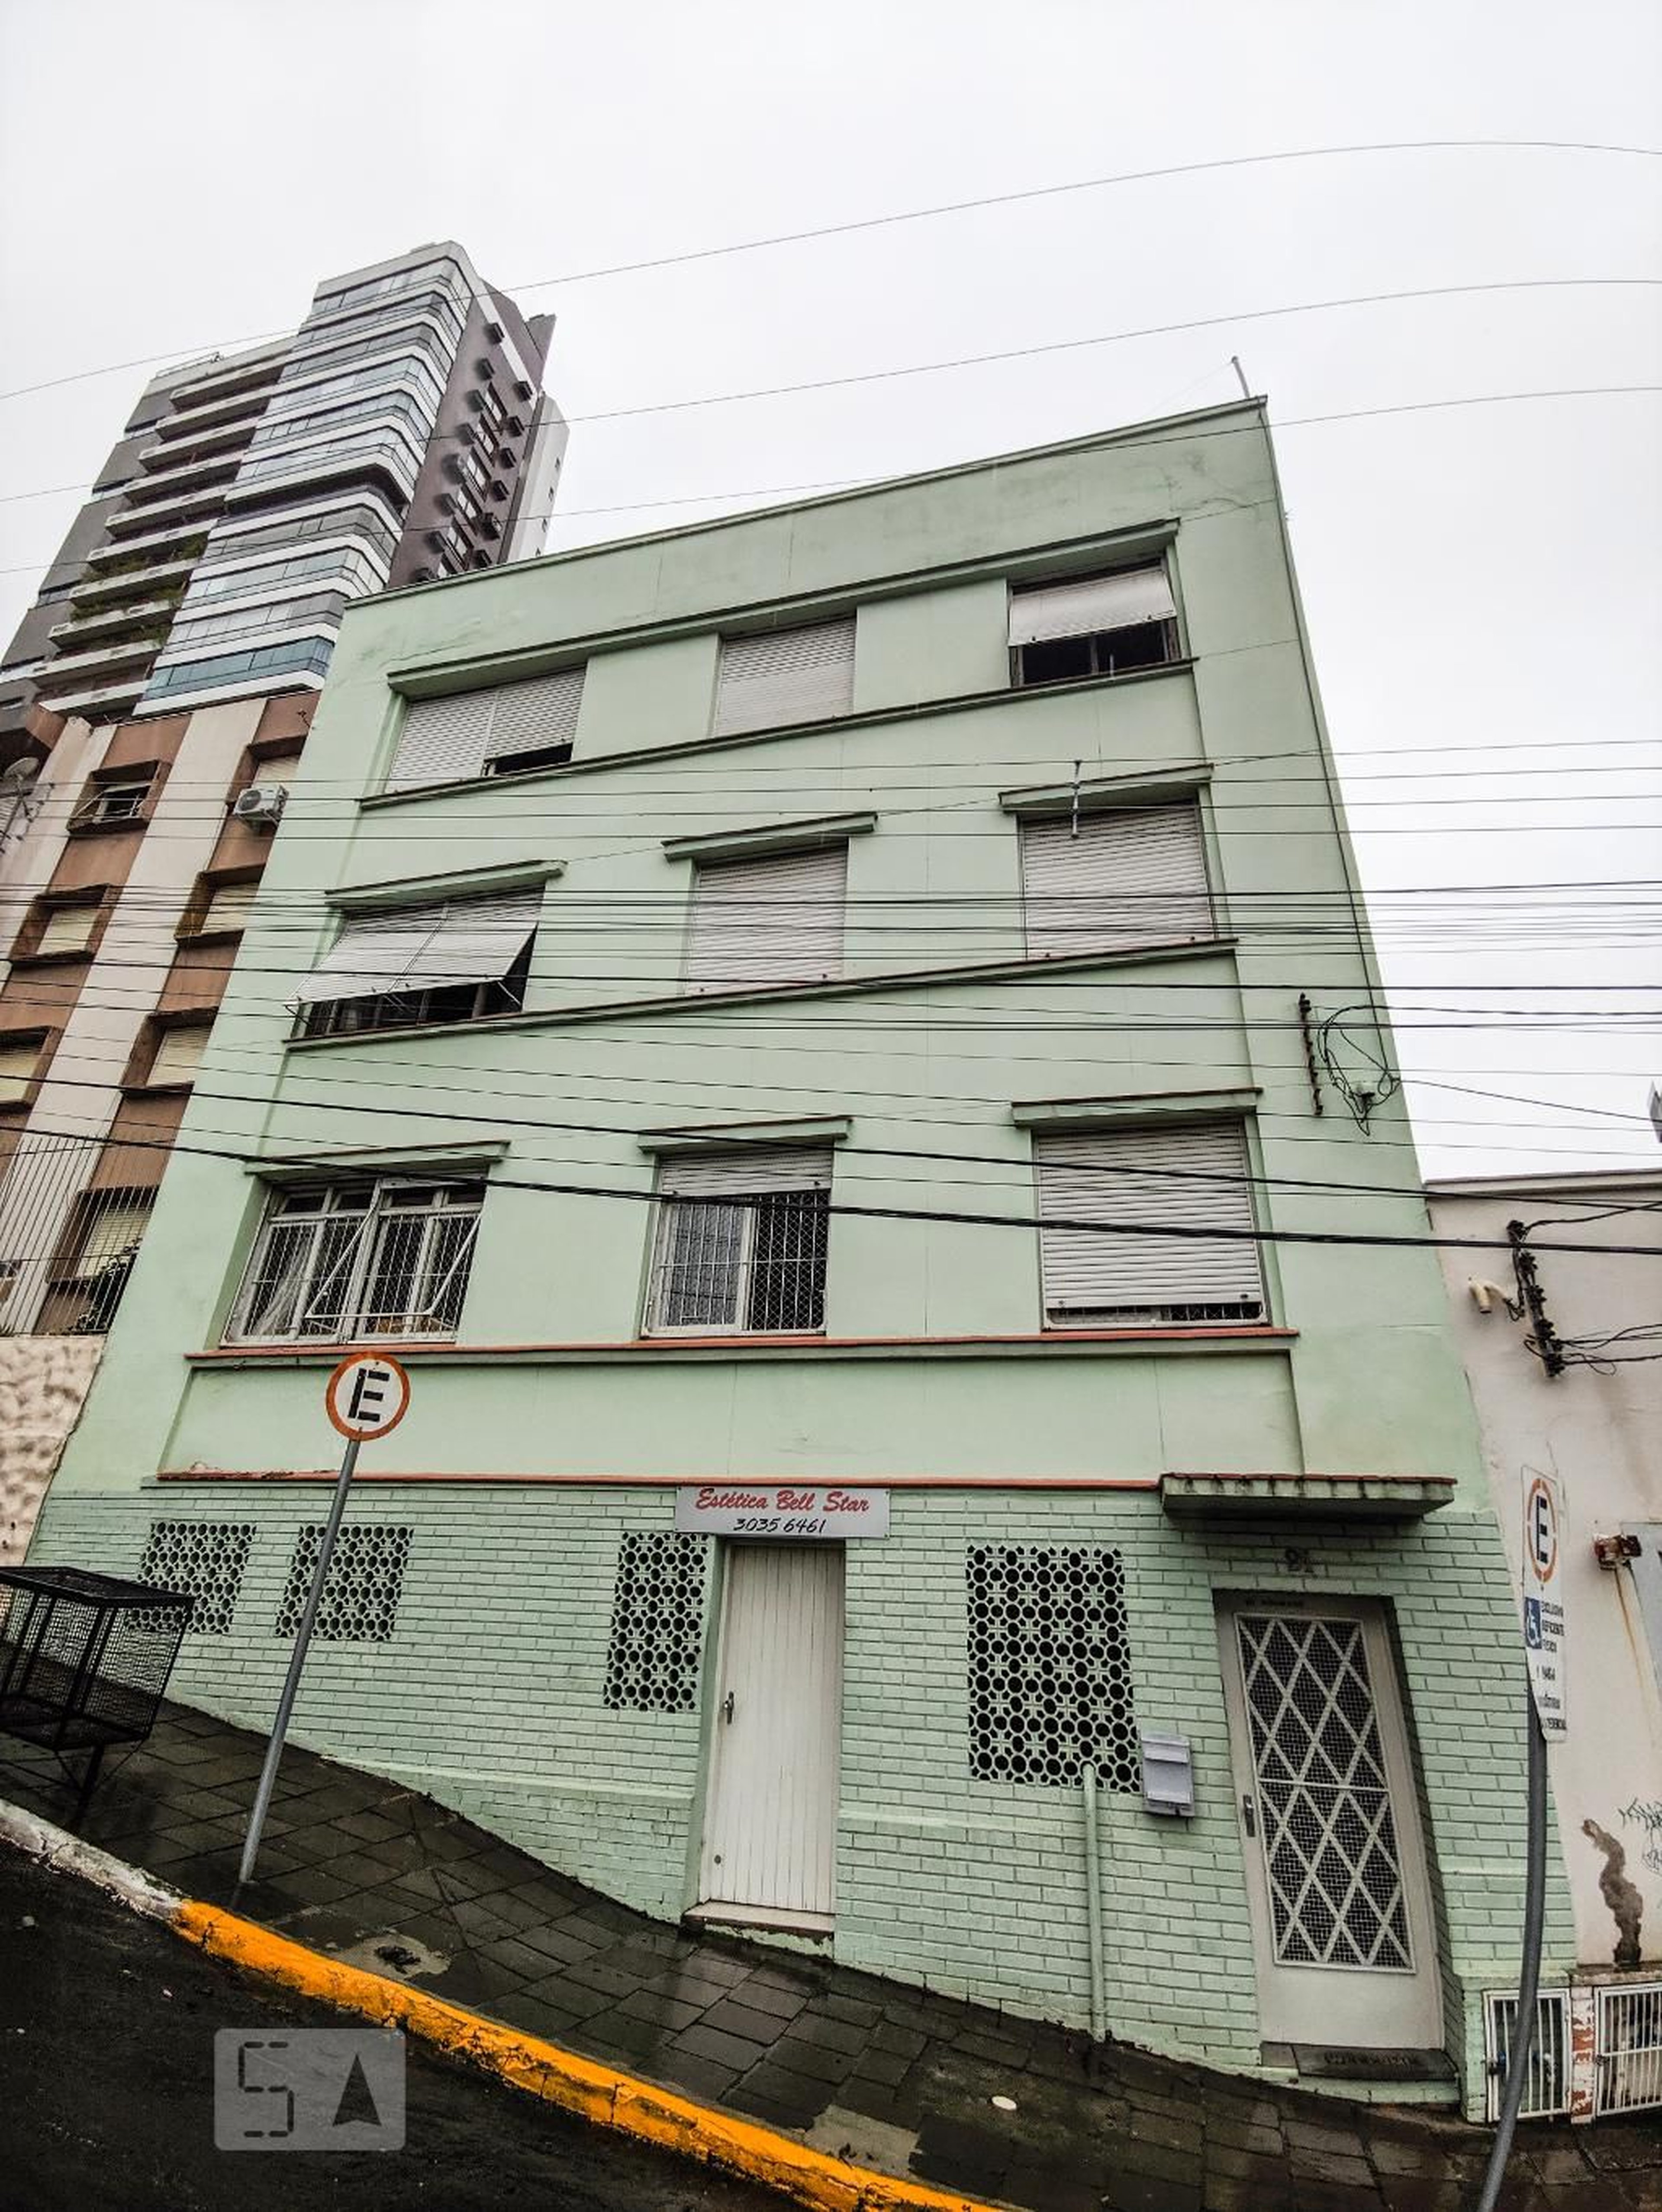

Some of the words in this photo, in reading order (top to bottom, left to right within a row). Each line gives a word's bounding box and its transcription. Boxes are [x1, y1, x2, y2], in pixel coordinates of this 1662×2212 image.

[348, 1368, 390, 1422] E
[776, 1490, 815, 1510] Bell
[823, 1491, 869, 1511] Star
[734, 1518, 781, 1532] 3035
[783, 1519, 826, 1533] 6461
[1536, 1495, 1548, 1564] E
